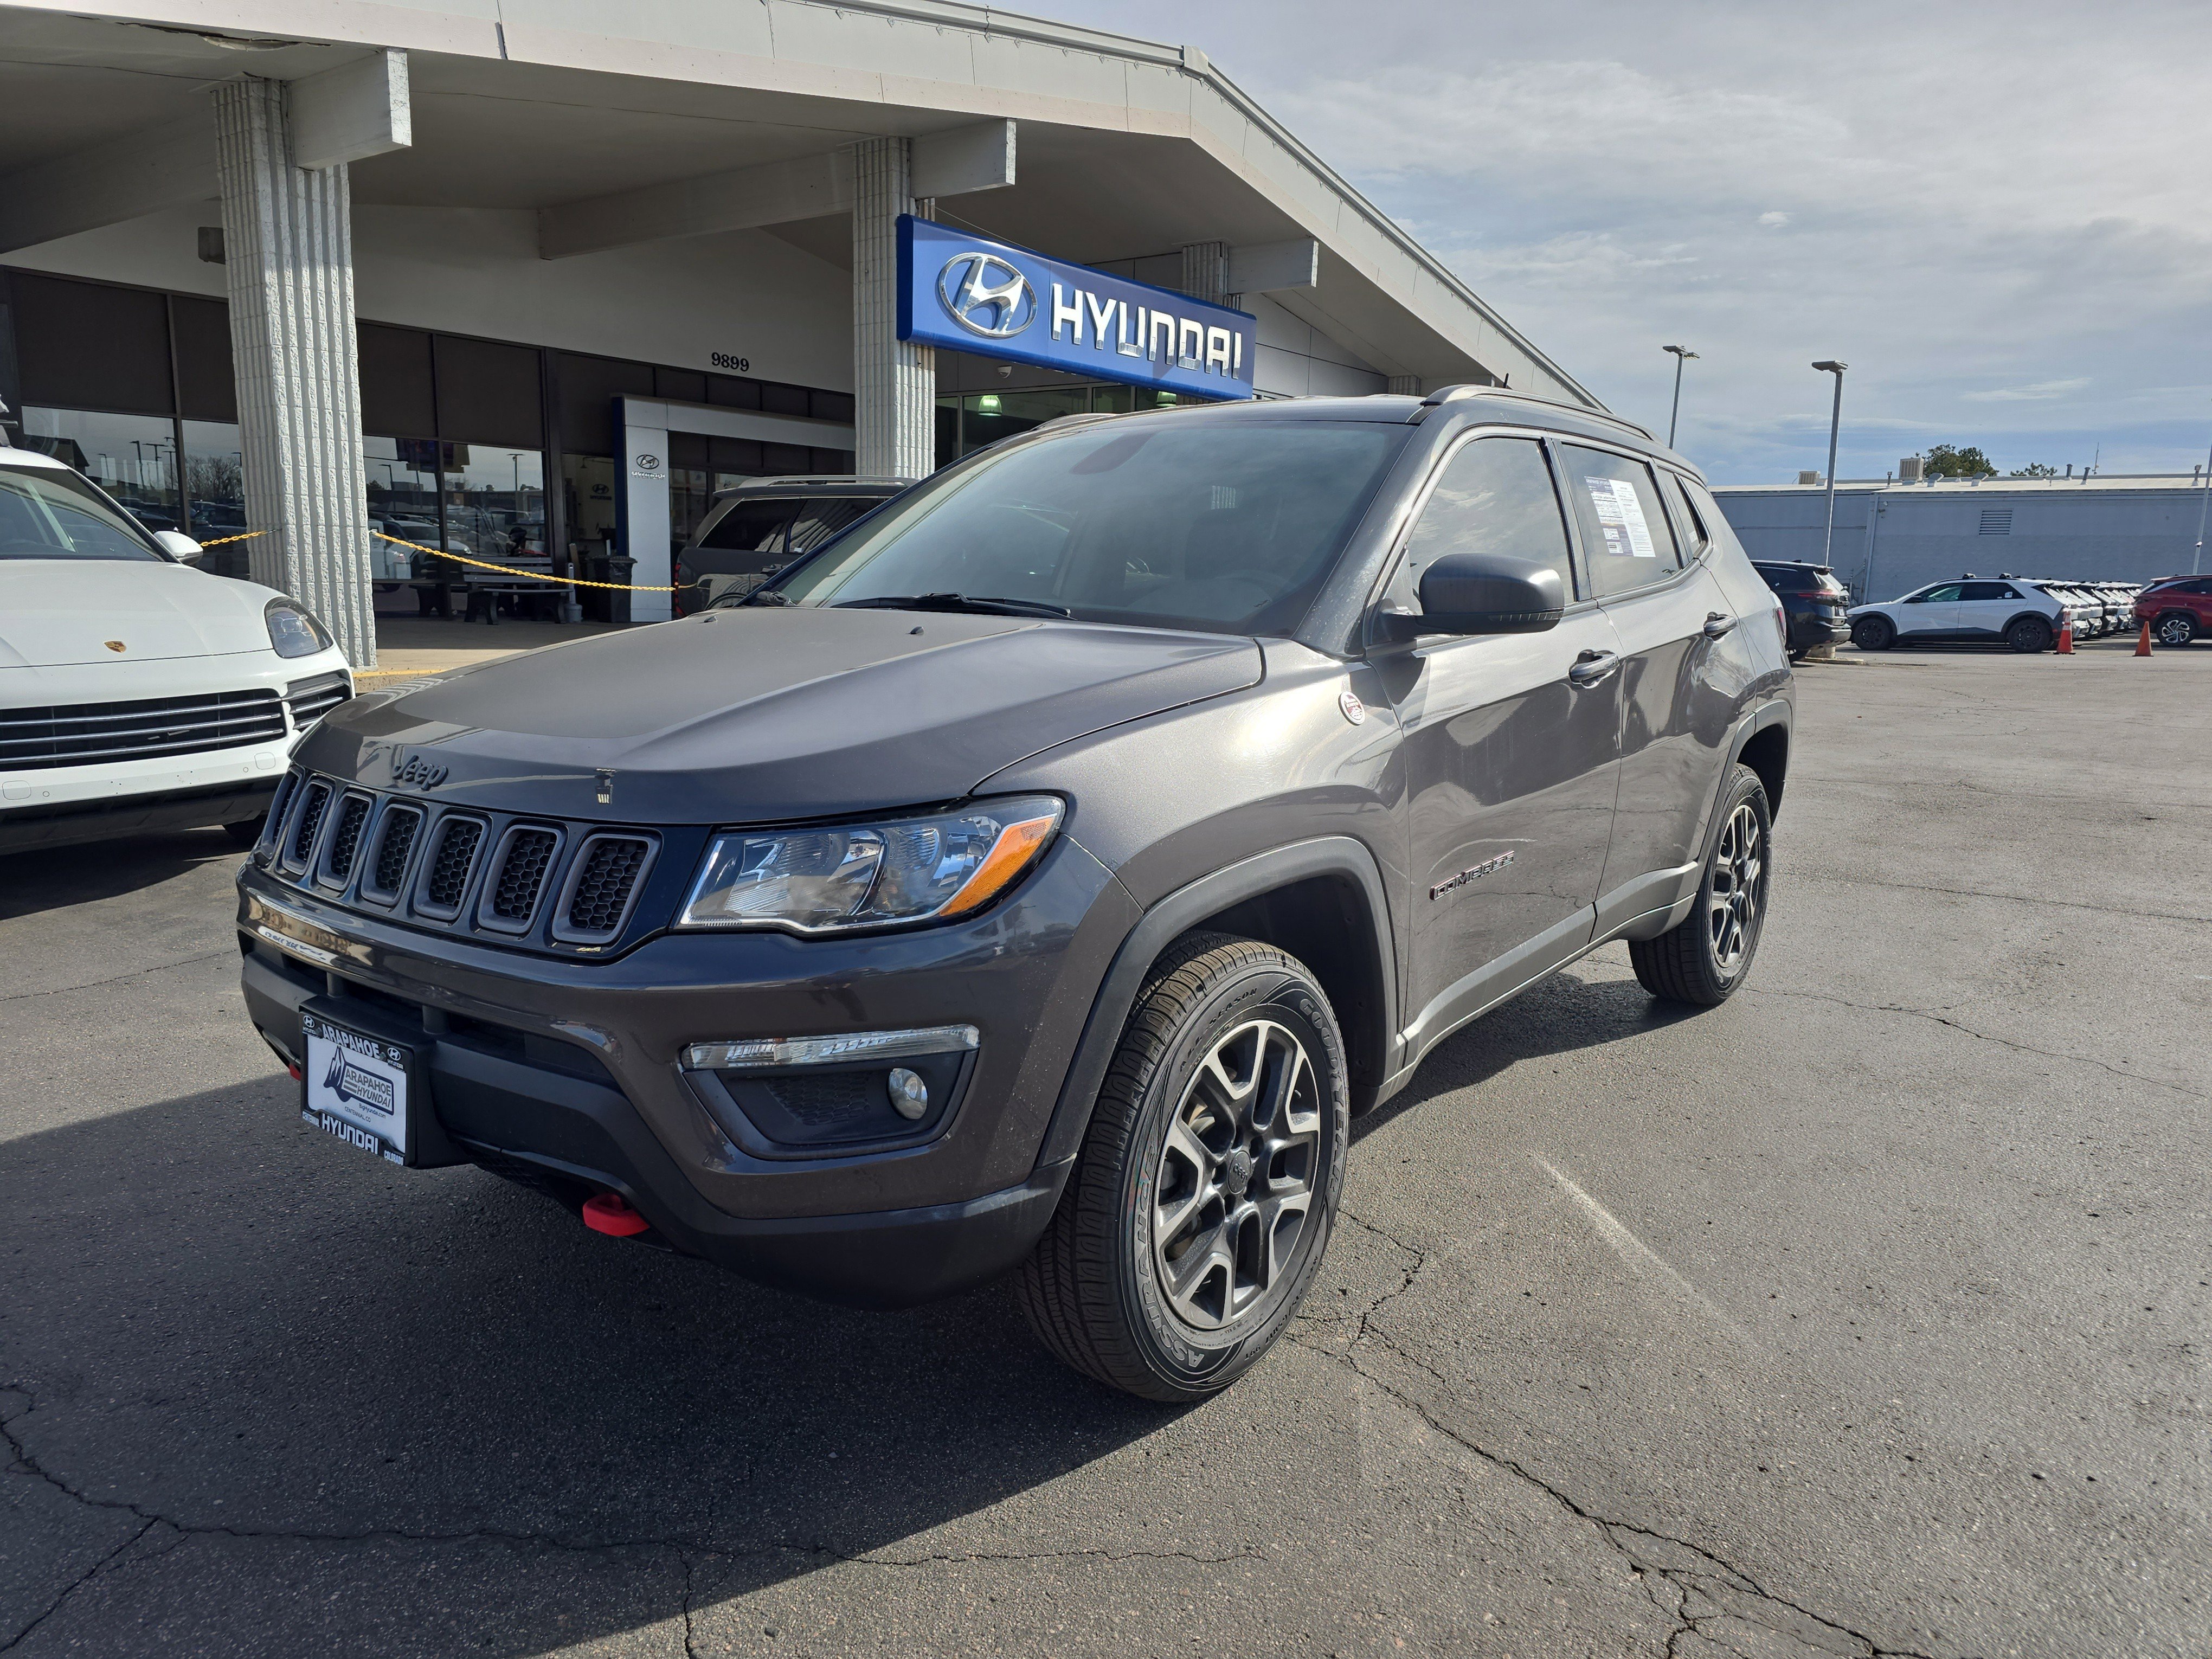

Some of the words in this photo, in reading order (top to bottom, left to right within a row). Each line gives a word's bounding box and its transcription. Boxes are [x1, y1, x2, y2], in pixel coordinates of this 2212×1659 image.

[1052, 282, 1242, 380] HYUNDAI
[711, 352, 749, 372] 9899
[391, 755, 448, 791] Jeep
[1430, 850, 1515, 901] COMPASS
[321, 1024, 381, 1059] ARAPAHOE
[345, 1068, 391, 1097] ARAPAHOE
[357, 1086, 391, 1108] HYUNDAI
[1300, 998, 1344, 1192] GOODYEAR
[322, 1113, 378, 1154] HYUNDAI
[1233, 1162, 1248, 1183] Jeep
[1137, 1144, 1205, 1368] ASSURANCE
